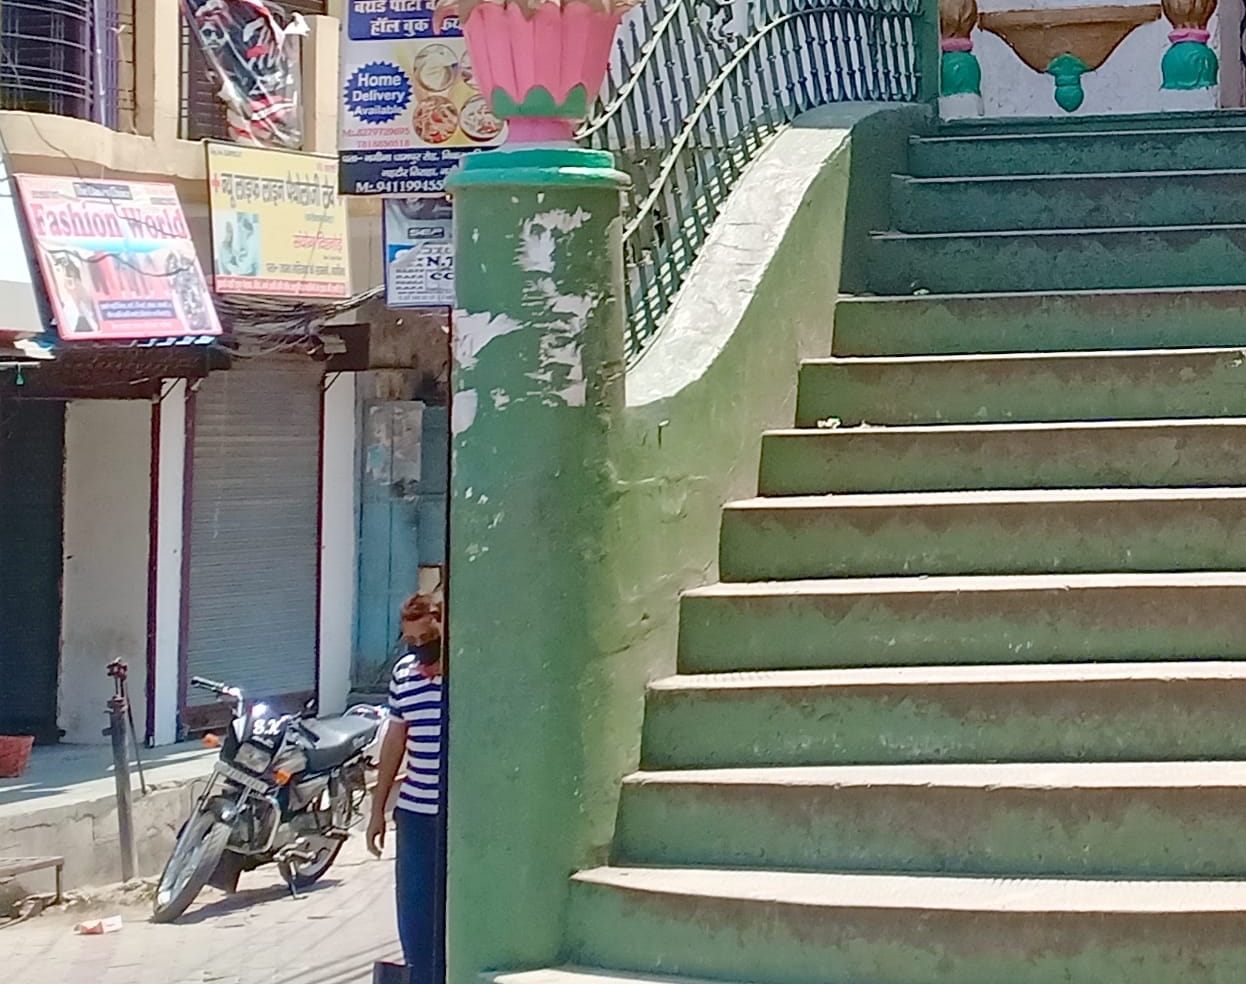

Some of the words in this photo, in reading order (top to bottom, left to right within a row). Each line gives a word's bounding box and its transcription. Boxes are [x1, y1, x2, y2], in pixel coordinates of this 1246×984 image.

[357, 73, 402, 87] Home
[352, 89, 406, 104] Delivery
[354, 105, 403, 116] Available
[30, 203, 124, 237] Fashion
[122, 207, 188, 239] World
